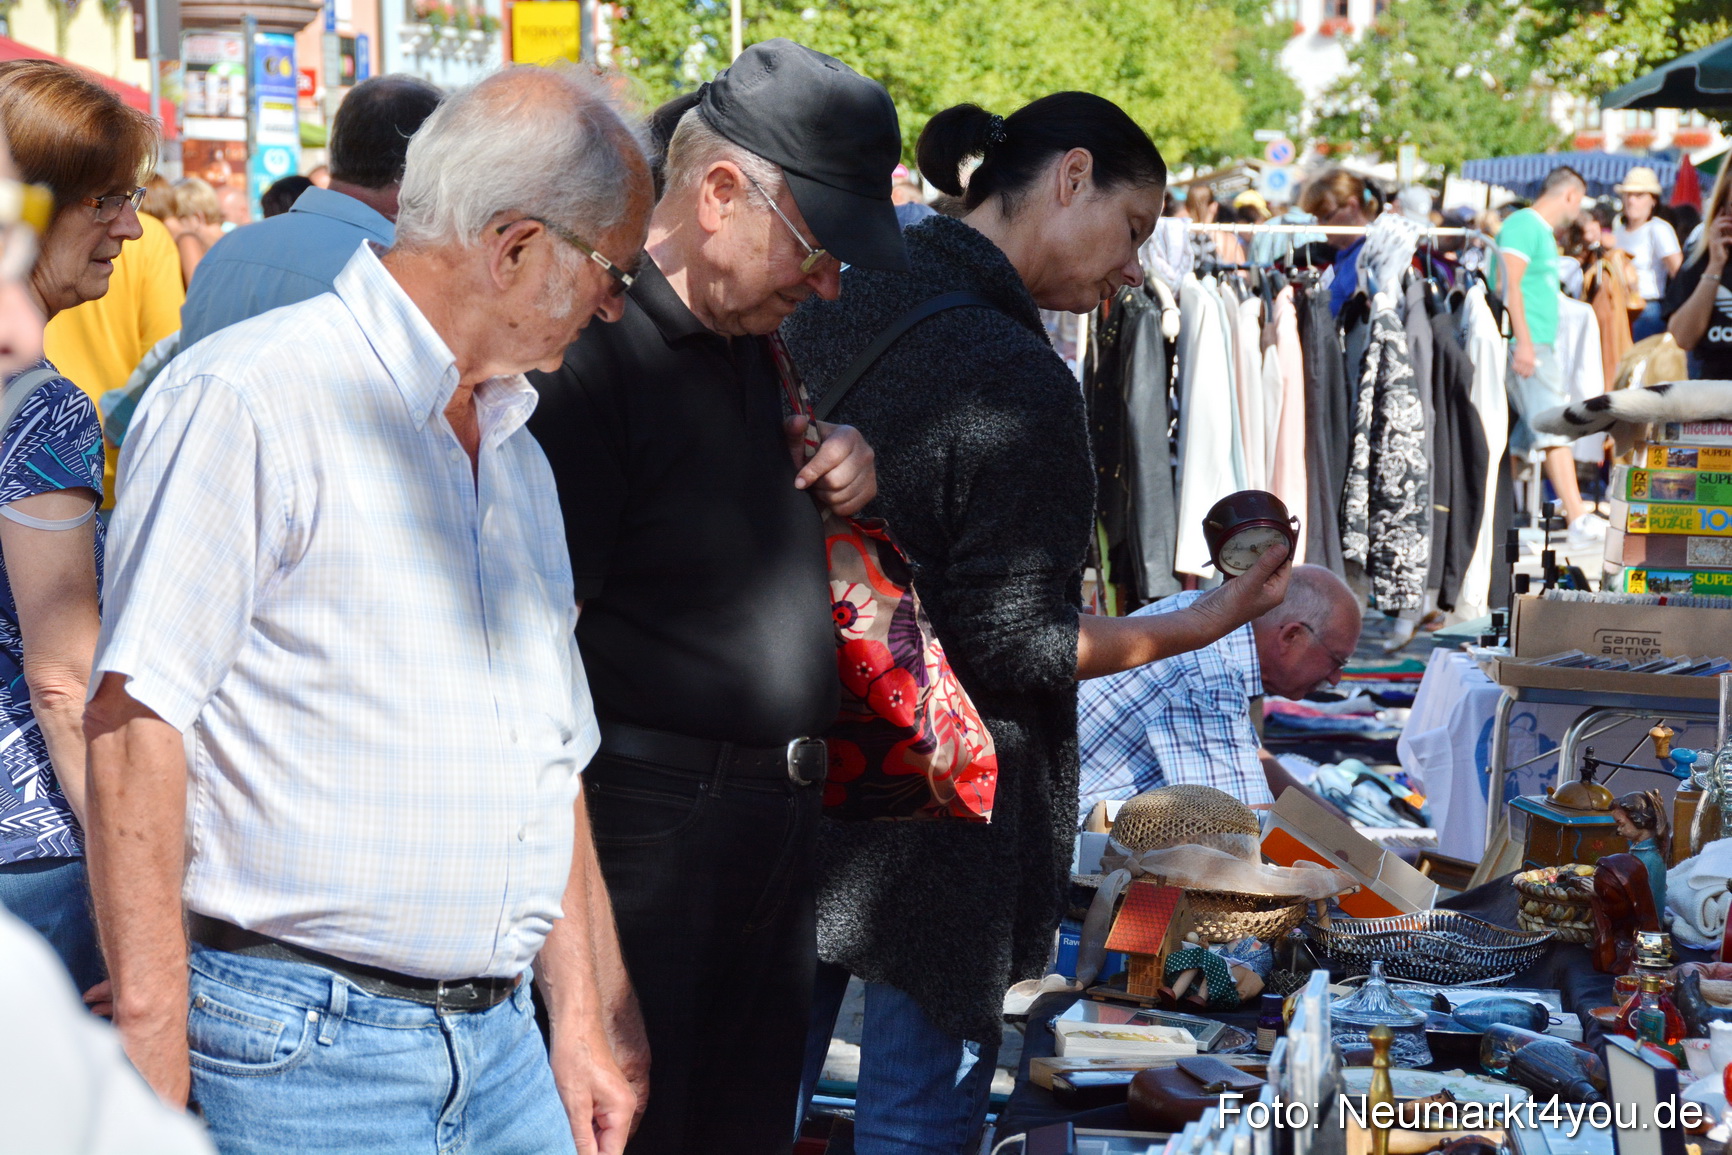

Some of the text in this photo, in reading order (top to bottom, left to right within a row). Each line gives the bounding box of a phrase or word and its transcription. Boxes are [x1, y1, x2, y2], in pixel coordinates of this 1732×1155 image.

[1701, 448, 1731, 457] SUPER
[1650, 506, 1693, 515] SCHMIDT
[1650, 516, 1693, 529] PUZZLE
[1698, 508, 1732, 531] 10
